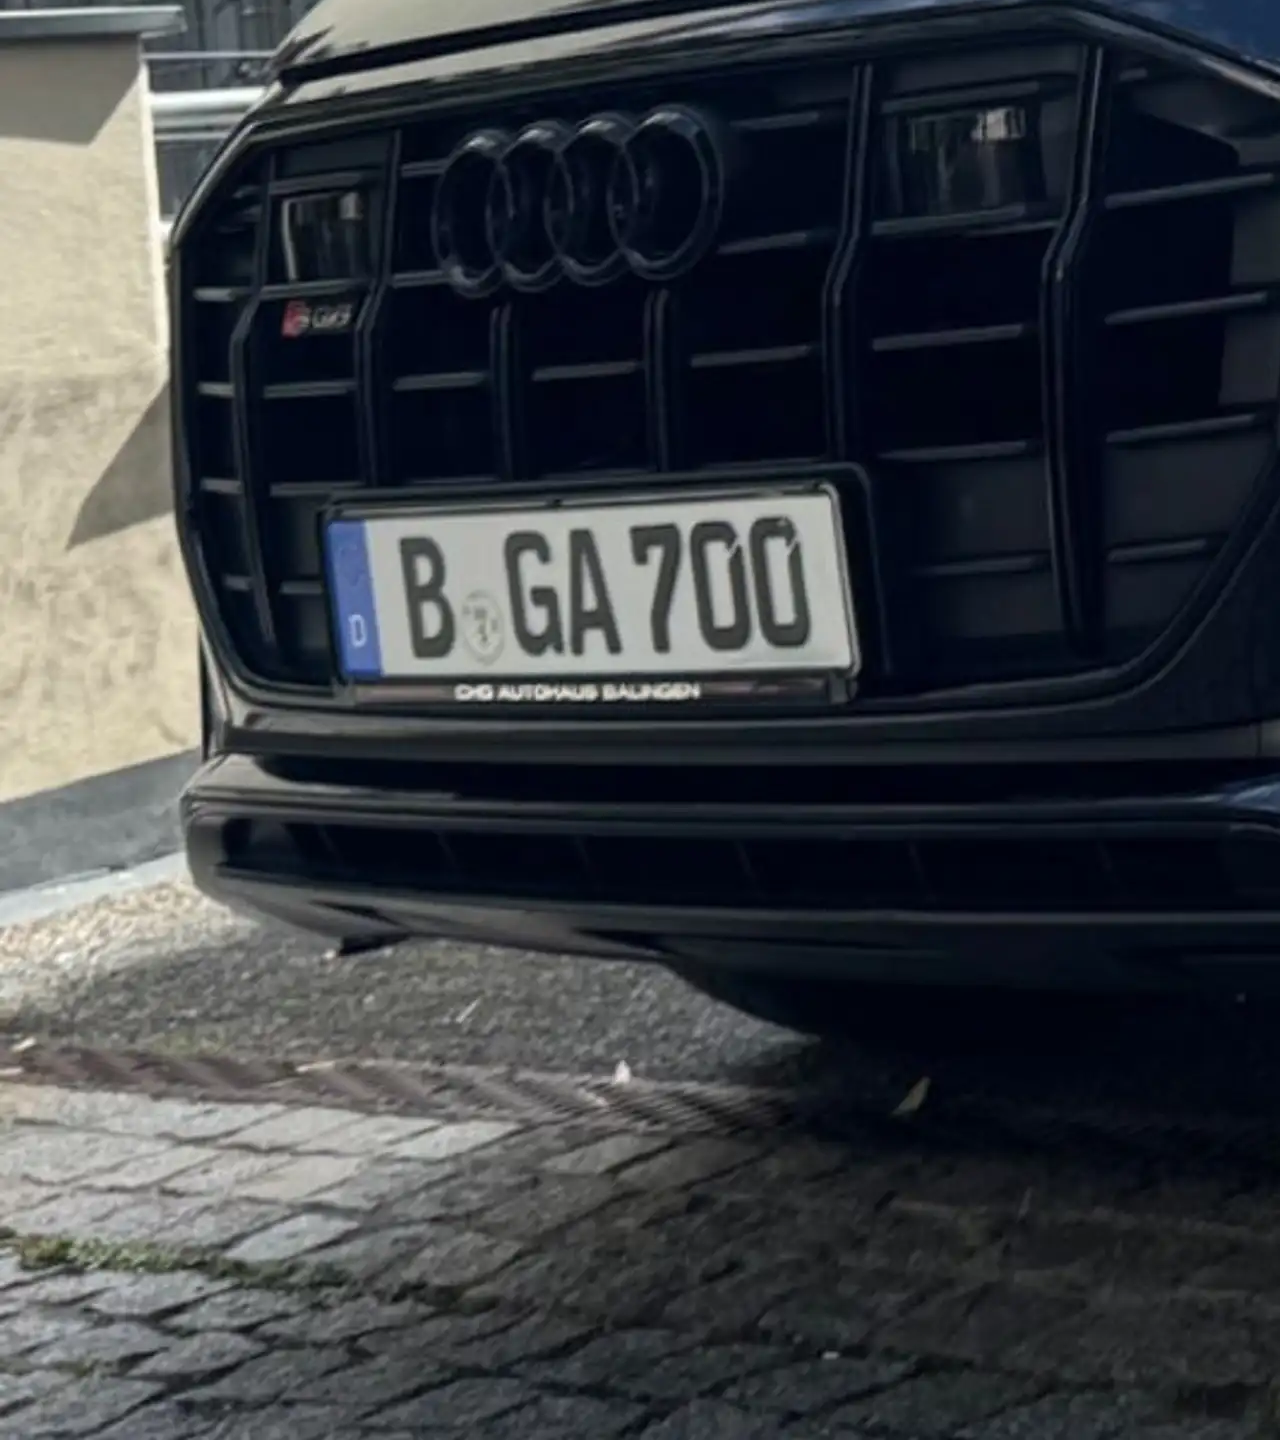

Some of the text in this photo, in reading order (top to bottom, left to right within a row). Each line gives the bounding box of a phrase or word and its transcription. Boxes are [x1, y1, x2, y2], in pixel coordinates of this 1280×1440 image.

[399, 536, 456, 659] B
[349, 614, 367, 648] D
[497, 683, 598, 702] AUTOHAUS
